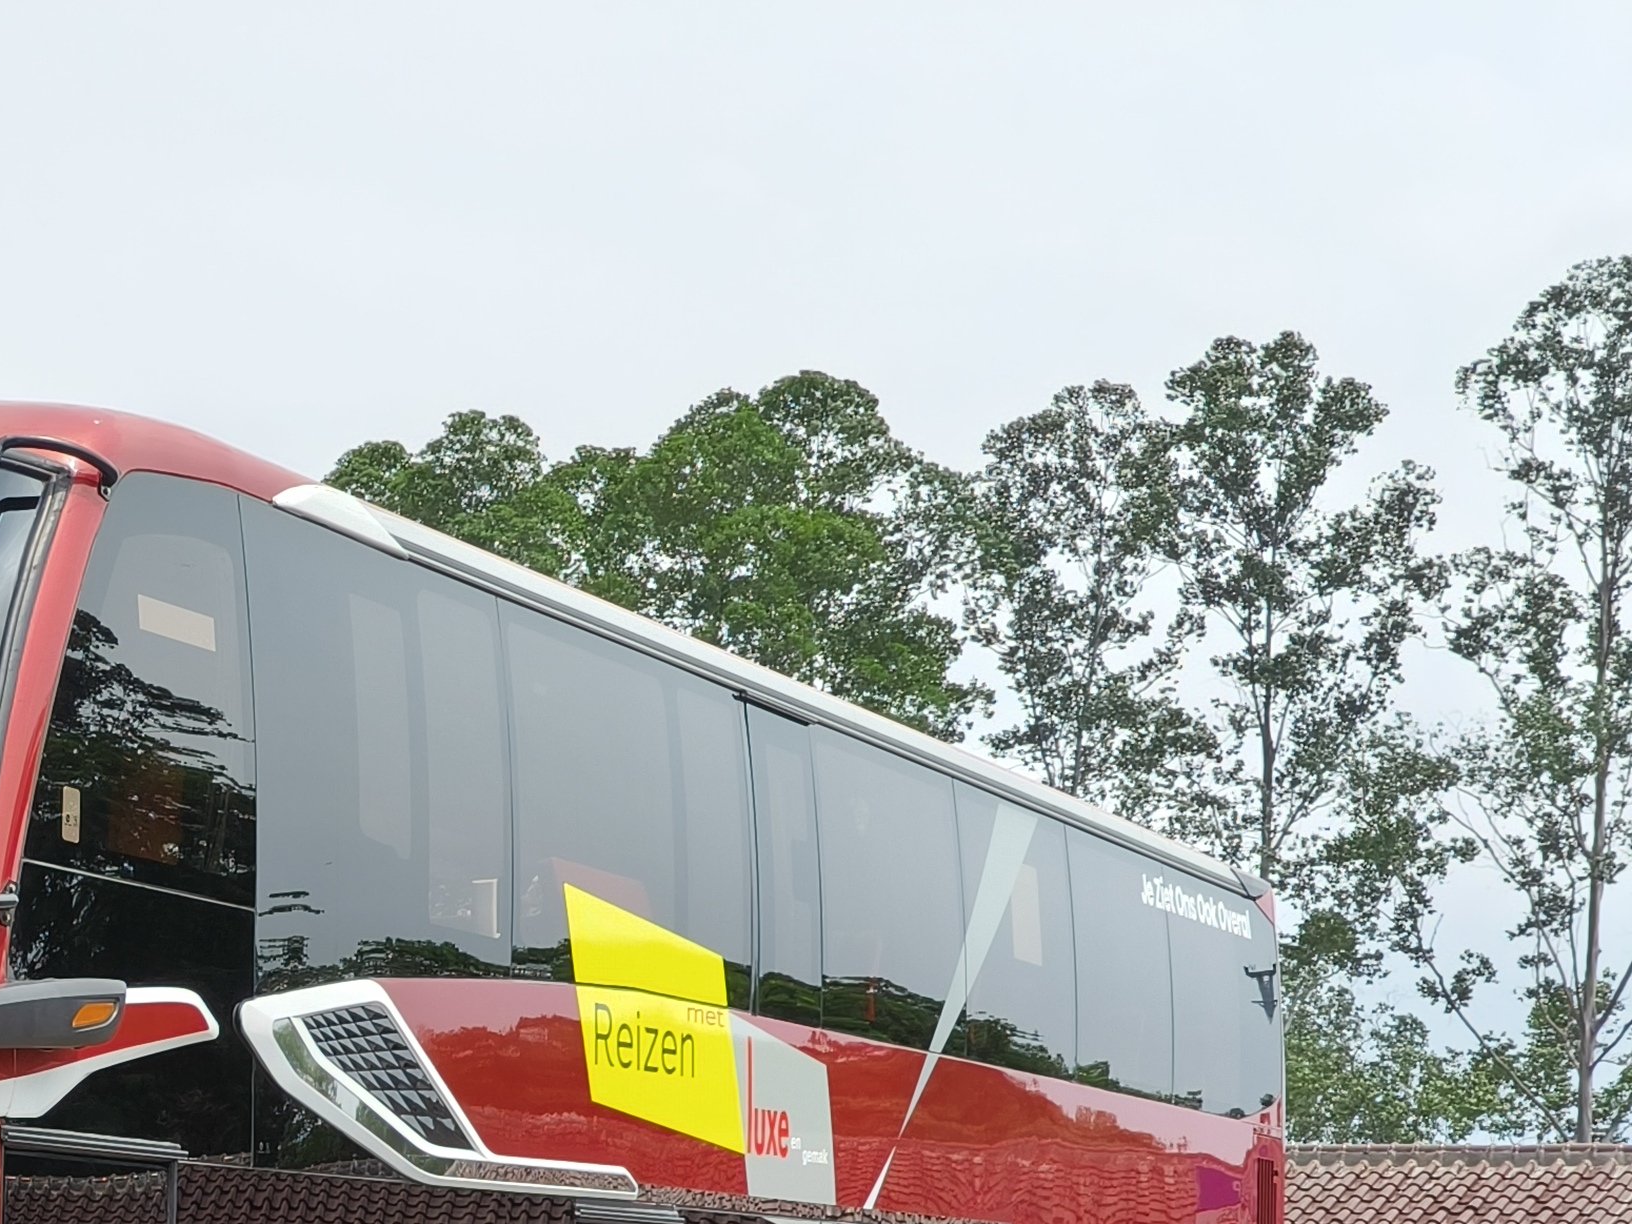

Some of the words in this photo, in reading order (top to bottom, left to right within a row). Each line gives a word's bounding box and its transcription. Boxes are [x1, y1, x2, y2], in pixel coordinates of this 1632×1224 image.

[1141, 873, 1155, 907] Je
[1175, 885, 1197, 921] Ons
[1196, 893, 1219, 929] Ook
[593, 1002, 696, 1079] Reizen
[687, 1006, 725, 1028] met
[746, 1035, 790, 1159] luxe
[790, 1135, 802, 1150] en
[801, 1148, 829, 1166] gemak
